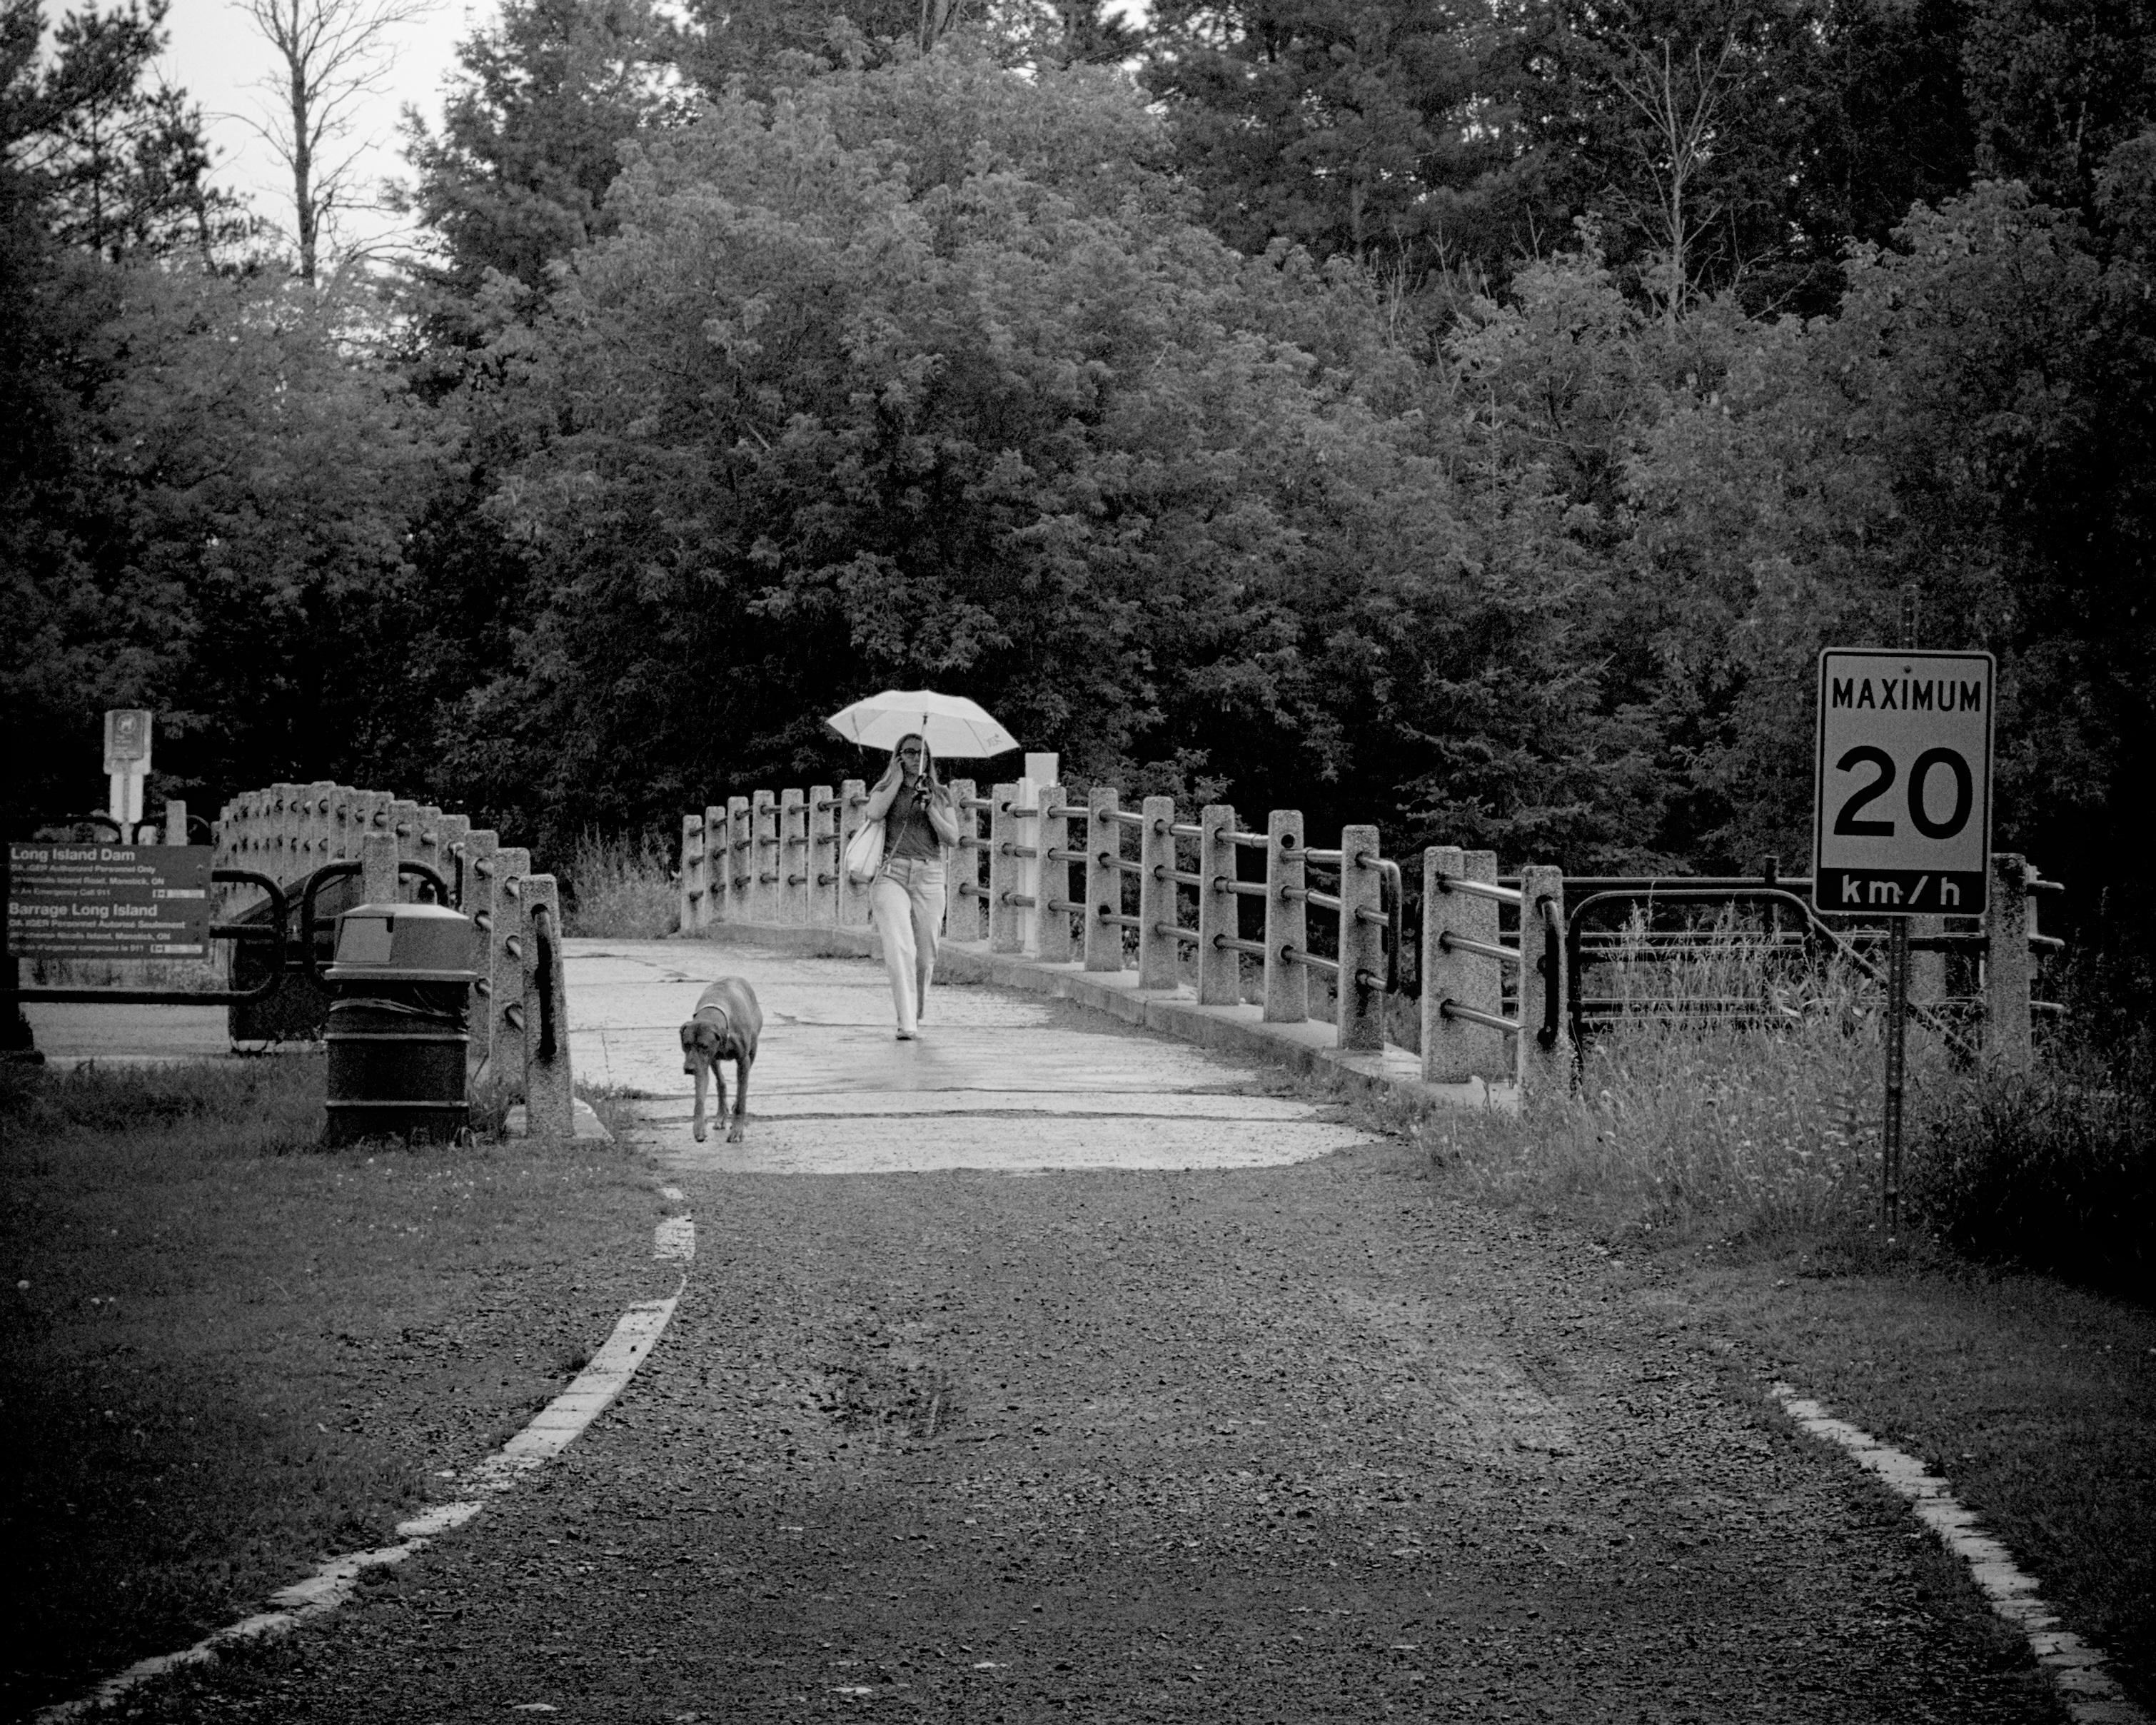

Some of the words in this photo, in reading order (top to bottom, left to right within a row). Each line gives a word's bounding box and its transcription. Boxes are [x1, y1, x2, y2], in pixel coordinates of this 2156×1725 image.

[1833, 678, 1981, 712] MAXIMUM
[1833, 745, 1973, 840] 20
[10, 847, 49, 862] Long
[52, 848, 97, 860] Island
[101, 848, 136, 861] Dam
[137, 865, 156, 875] Only
[1842, 874, 1960, 906] km/h
[9, 902, 68, 917] Barrage
[71, 902, 109, 919] Long
[113, 903, 158, 917] Island
[51, 919, 97, 927] Personnel
[138, 920, 186, 929] Seulement
